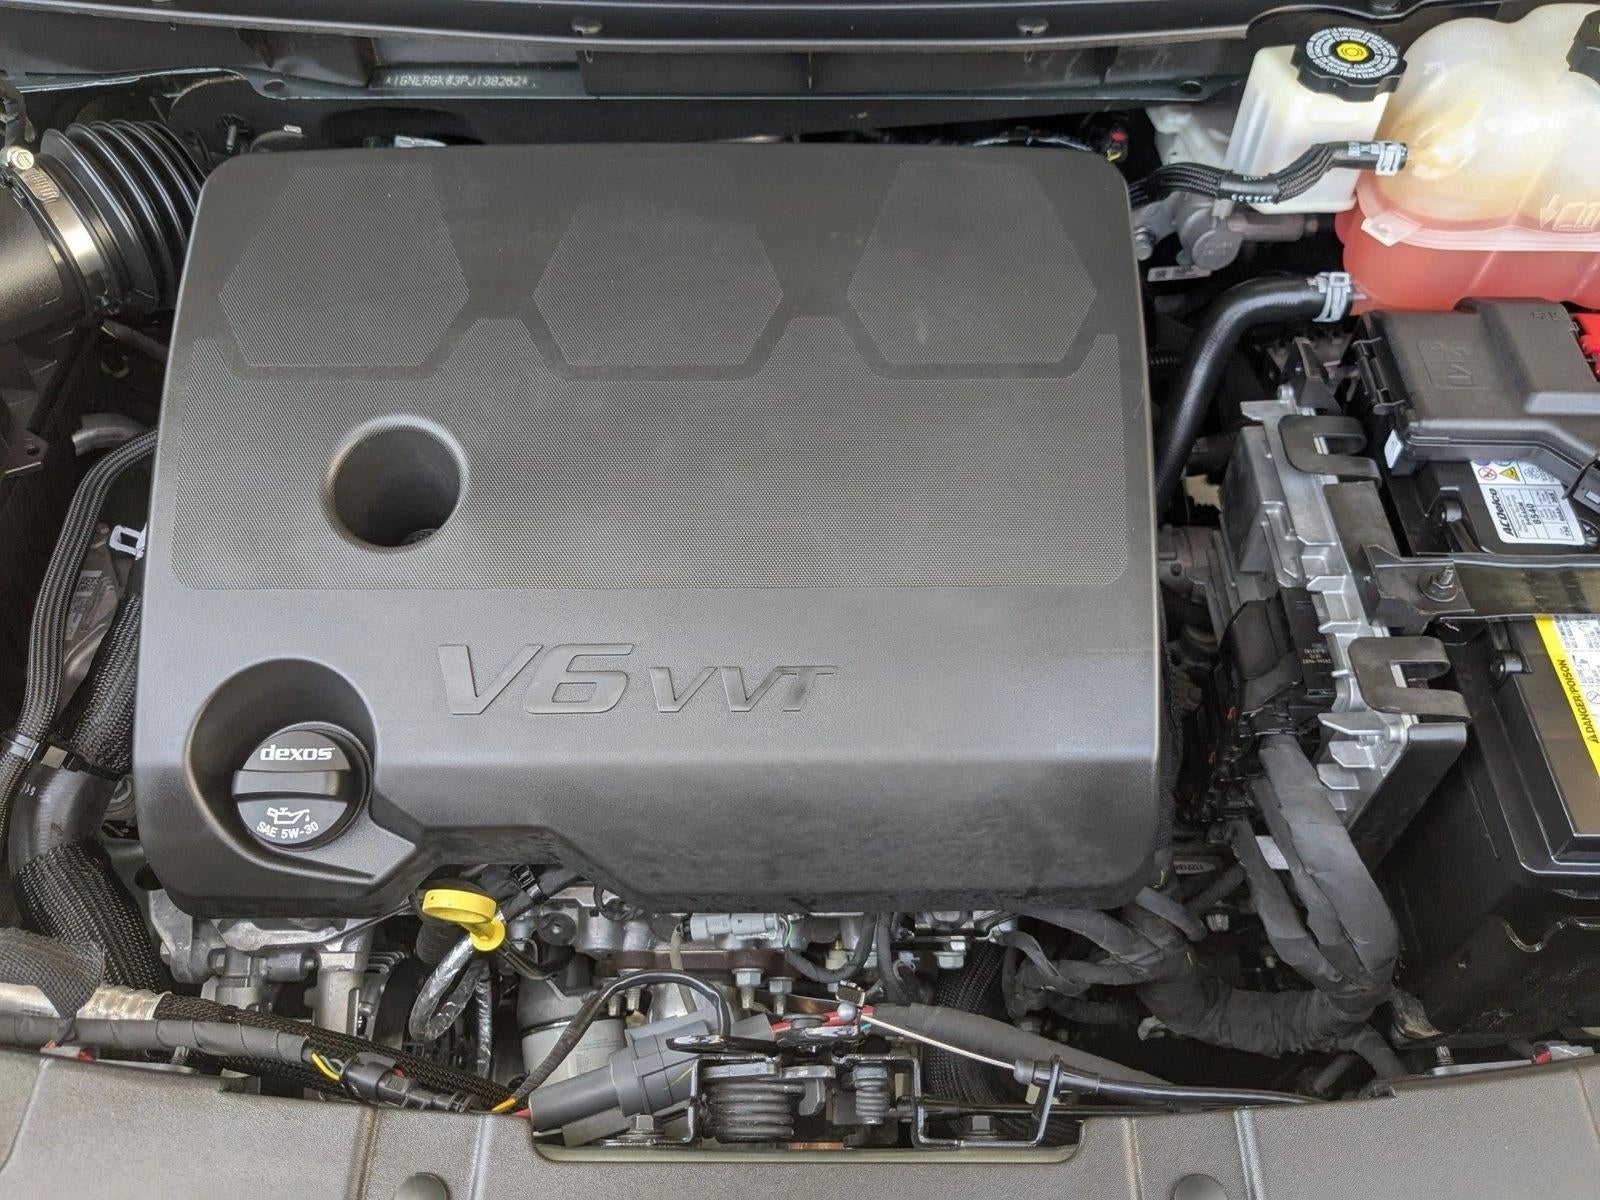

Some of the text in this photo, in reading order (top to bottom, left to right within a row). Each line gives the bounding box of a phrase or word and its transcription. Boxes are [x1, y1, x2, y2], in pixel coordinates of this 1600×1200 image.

[1489, 488, 1514, 537] ACDelco
[438, 643, 837, 715] V6 VVT
[260, 744, 335, 760] dexos
[257, 821, 319, 839] SAE 5W-30
